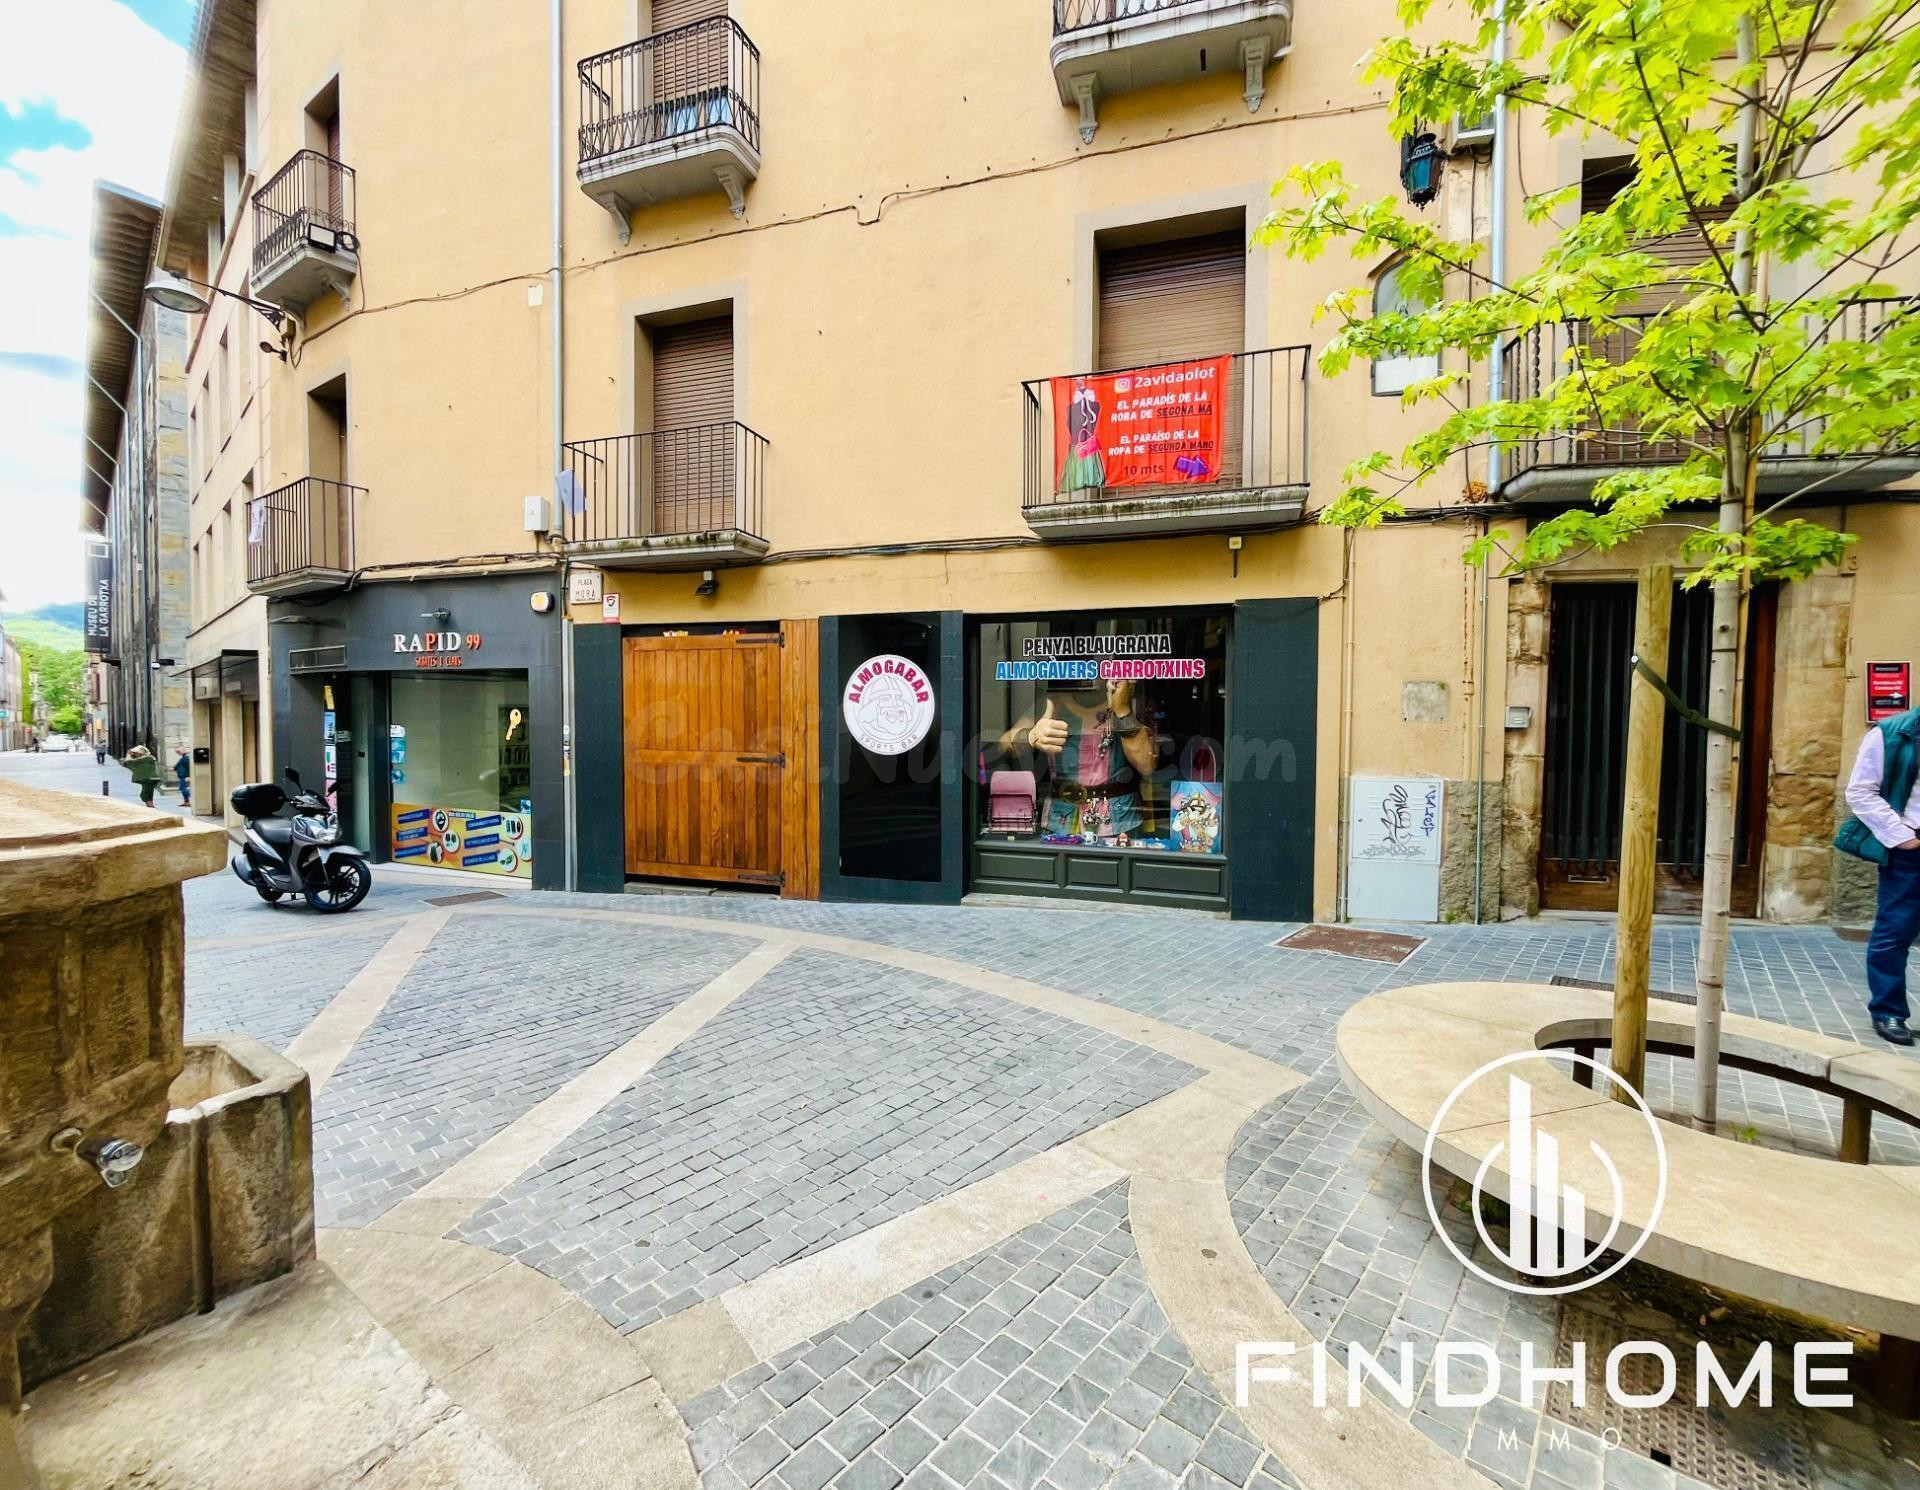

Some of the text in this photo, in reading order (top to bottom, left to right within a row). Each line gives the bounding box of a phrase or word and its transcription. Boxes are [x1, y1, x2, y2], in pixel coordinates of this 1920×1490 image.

[1134, 366, 1216, 388] 2avidaolot
[1116, 390, 1207, 410] EL PARADÍS DE LA
[1111, 411, 1137, 423] ROBA
[1140, 409, 1153, 419] DE
[1156, 404, 1195, 418] SEGONA
[1120, 435, 1131, 445] EL
[1173, 430, 1185, 441] DE
[1187, 429, 1199, 440] LA
[1108, 440, 1214, 457] ROPA DE SEGUNDA MANO
[1123, 463, 1164, 476] 10 mts
[88, 594, 98, 636] MUSEU DE
[99, 579, 109, 637] LA GARROTXA
[393, 631, 482, 653] RAPID 99
[1022, 634, 1172, 657] PENYA BLAUGRANA
[995, 656, 1206, 681] ALMOGÀVERS GARROTXINS
[848, 659, 930, 704] ALMOGABAR
[860, 733, 918, 752] SPORTS BAR
